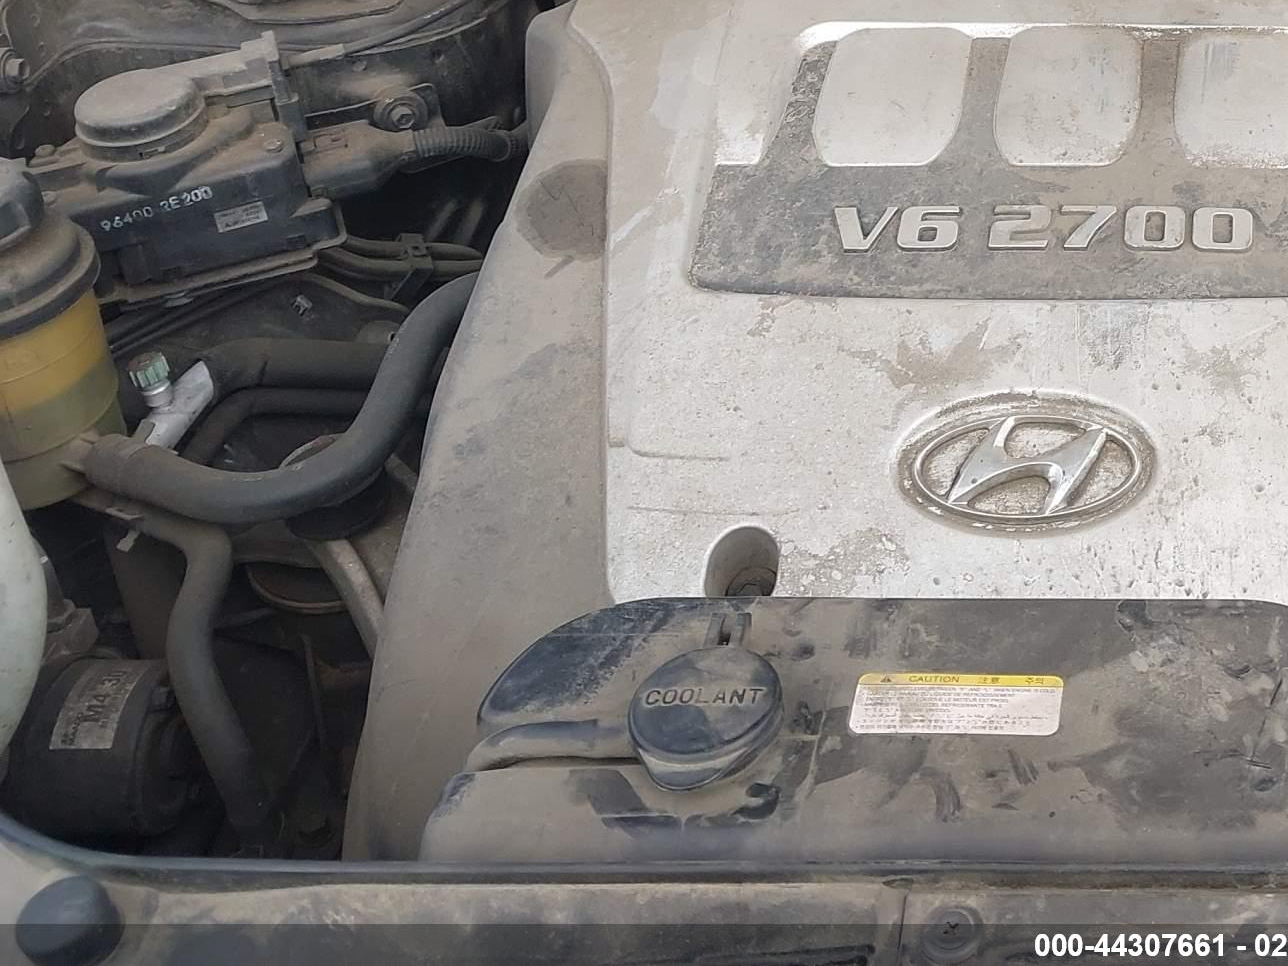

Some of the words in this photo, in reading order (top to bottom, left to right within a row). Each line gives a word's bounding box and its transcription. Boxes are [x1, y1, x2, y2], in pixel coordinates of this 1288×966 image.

[833, 205, 961, 253] V6
[986, 204, 1254, 251] 2700
[908, 675, 960, 683] CAUTION
[645, 688, 765, 706] COOLANT
